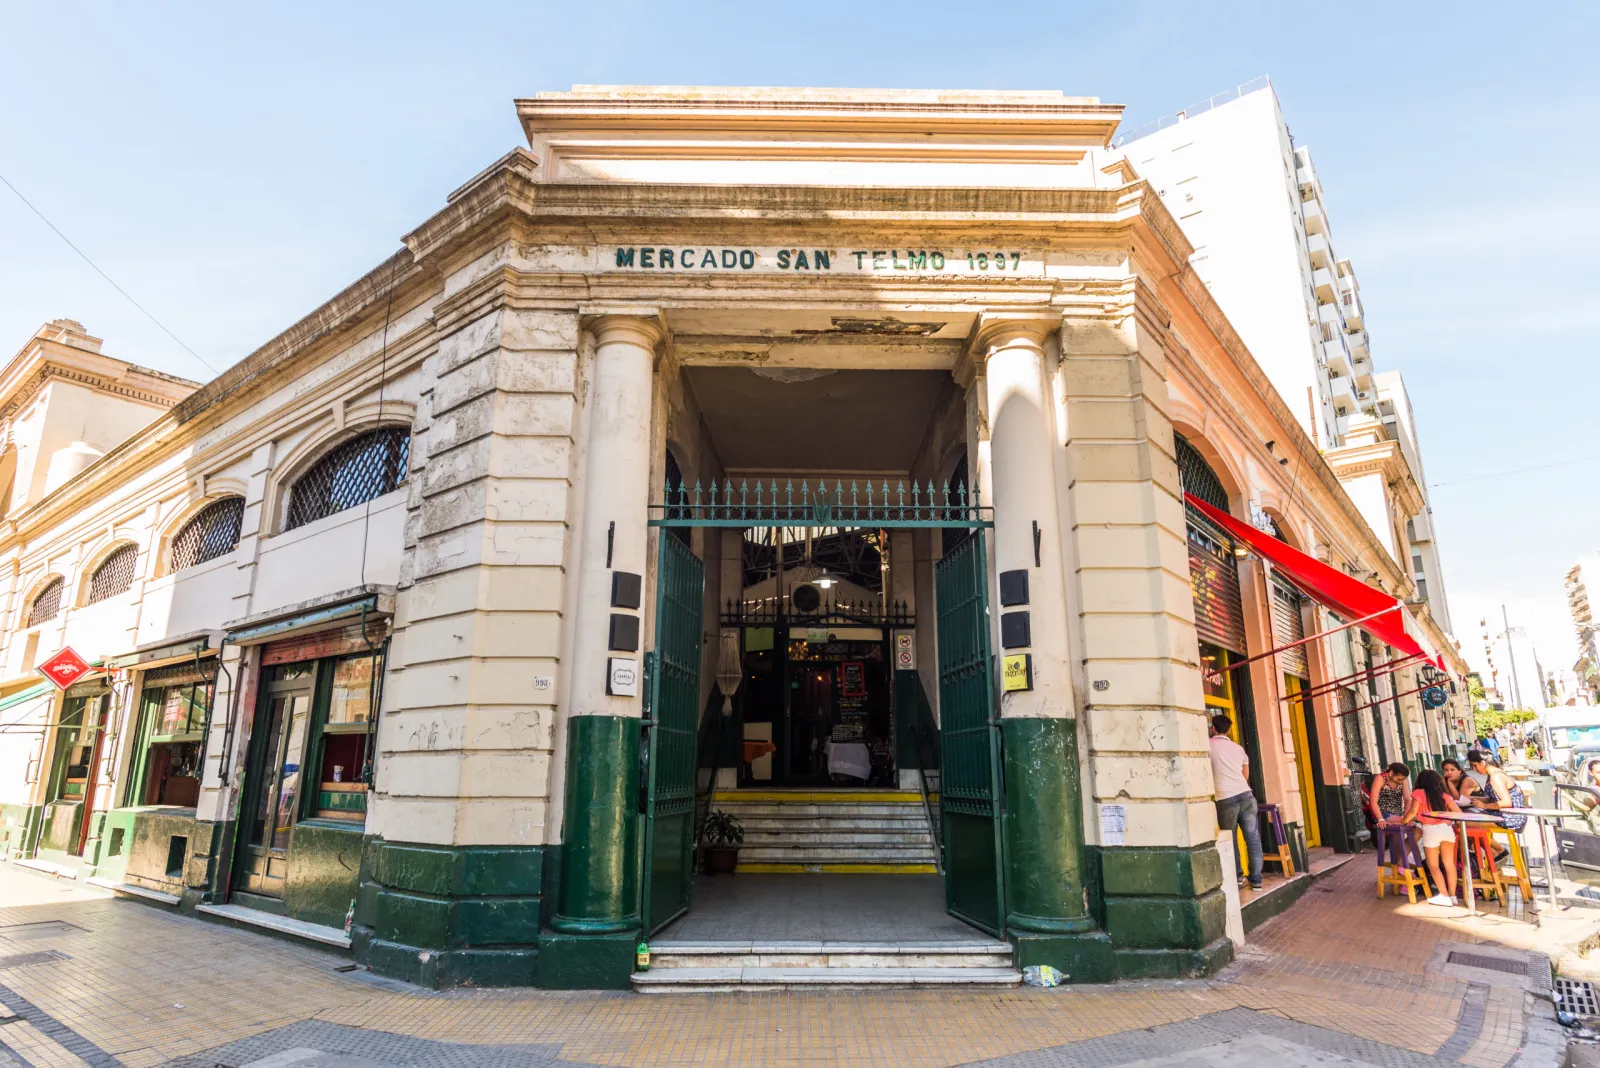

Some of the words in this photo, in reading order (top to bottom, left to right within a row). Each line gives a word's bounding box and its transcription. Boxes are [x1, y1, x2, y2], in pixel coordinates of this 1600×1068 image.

[616, 247, 756, 270] MERCADO
[777, 249, 831, 270] SAN
[852, 250, 946, 270] TELMO
[967, 252, 1022, 271] 1897
